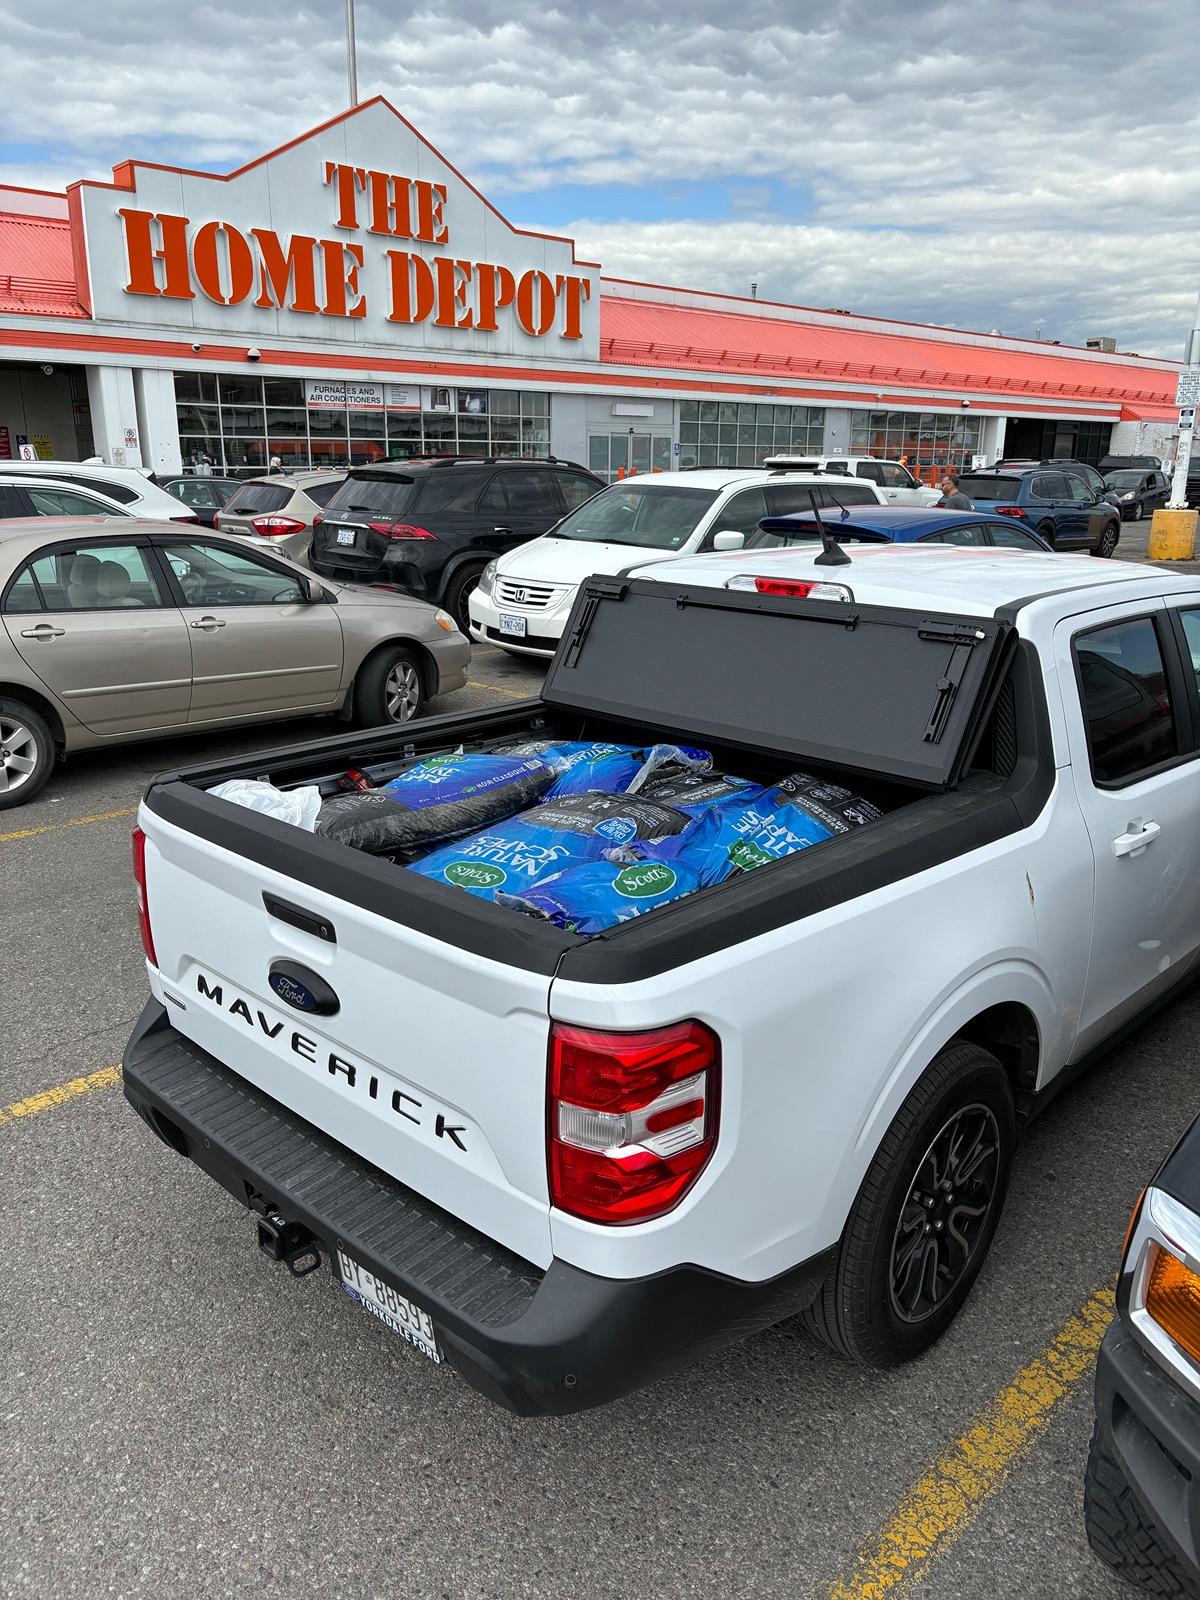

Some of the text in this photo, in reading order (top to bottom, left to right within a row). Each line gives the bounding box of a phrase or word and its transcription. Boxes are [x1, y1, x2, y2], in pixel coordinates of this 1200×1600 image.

[324, 161, 449, 244] THE
[118, 207, 590, 340] HOME DEPOT
[309, 394, 323, 402] AIR
[314, 385, 375, 396] FURNACES AND
[457, 844, 550, 876] NATURE
[471, 836, 570, 862] SCAPES
[453, 865, 499, 884] Scotts
[621, 865, 669, 892] Scotts
[278, 976, 306, 1006] Ford
[197, 974, 469, 1152] MAVERICK
[374, 1278, 434, 1341] 88593
[360, 1294, 412, 1342] YORKDALE
[412, 1337, 441, 1365] FORD
